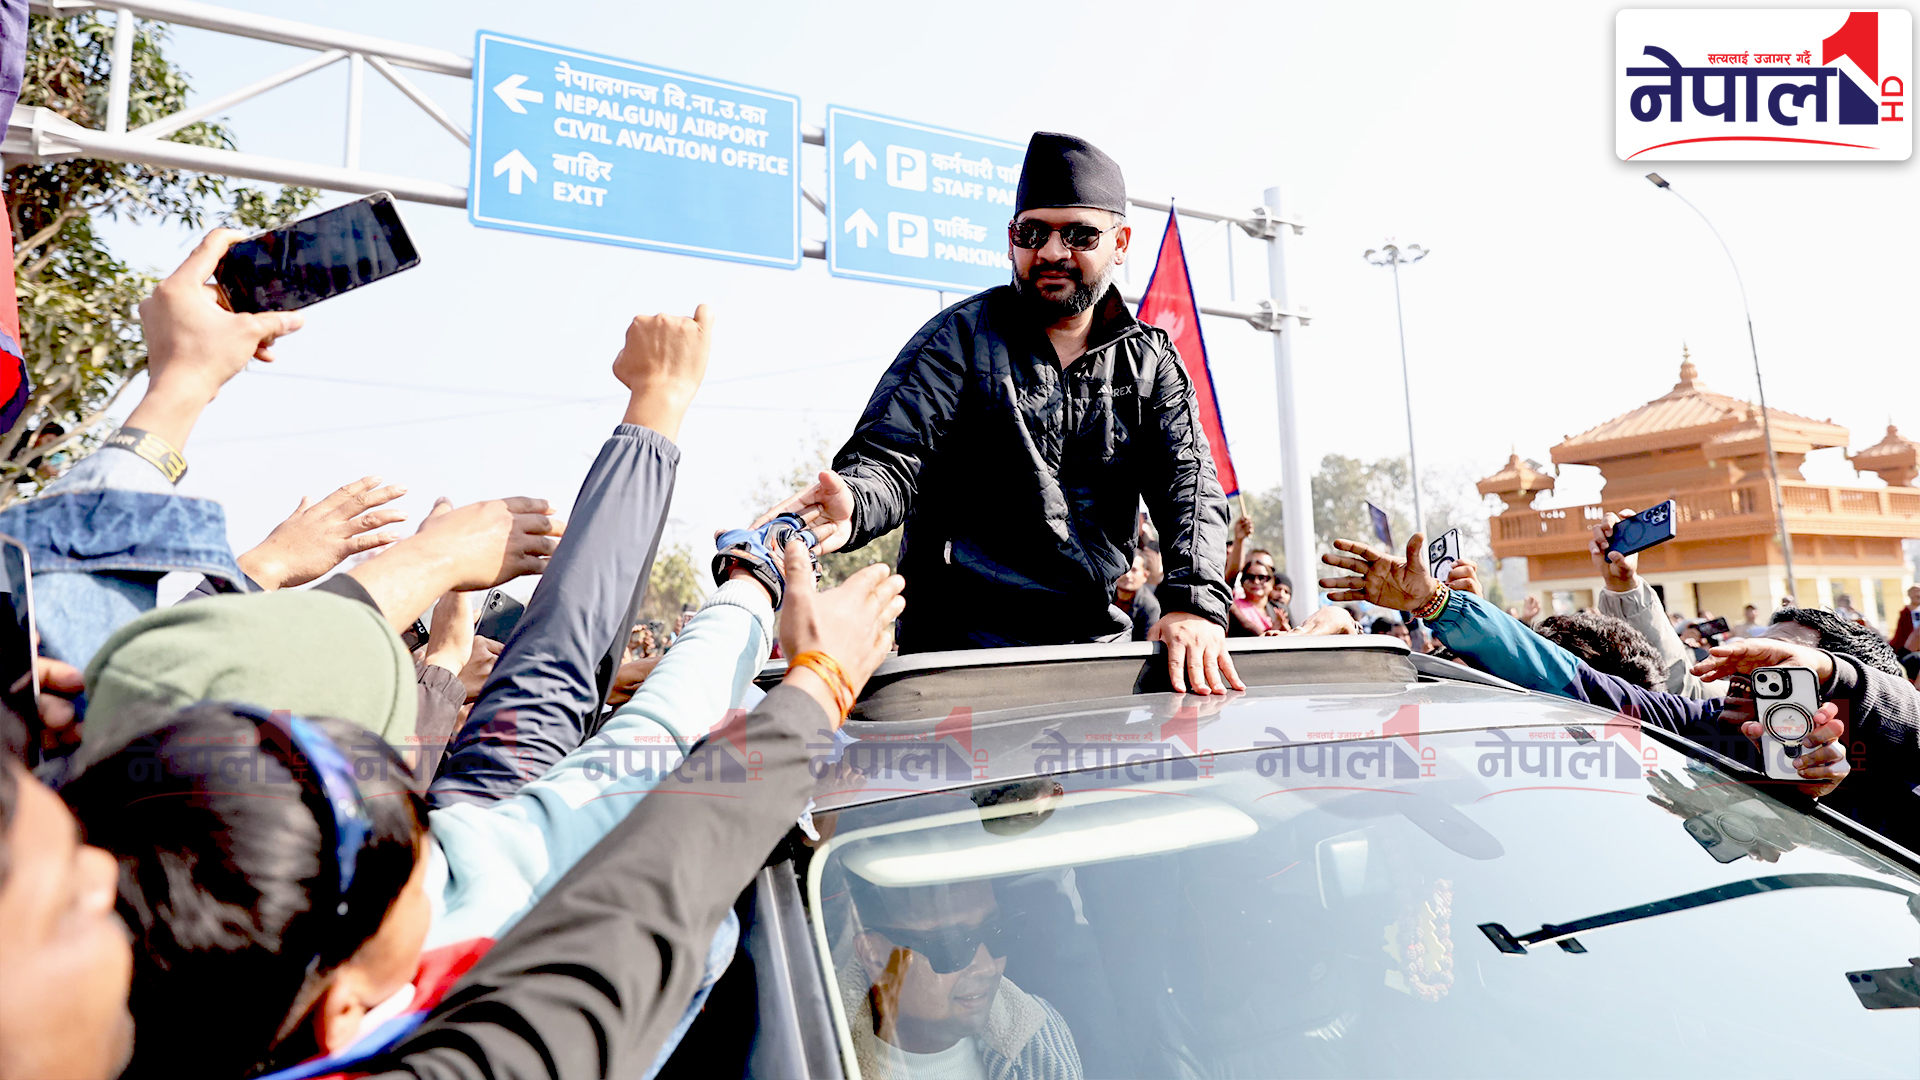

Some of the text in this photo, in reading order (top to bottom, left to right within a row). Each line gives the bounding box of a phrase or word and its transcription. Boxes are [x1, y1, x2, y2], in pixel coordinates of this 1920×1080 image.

[554, 61, 659, 104] नेपालगन्ज
[555, 91, 769, 148] NEPALGUNJ AIRPORT
[554, 117, 789, 176] CIVIL AVIATION OFFICE
[552, 151, 614, 183] बाहिर
[931, 152, 994, 180] कर्मचारी
[553, 181, 607, 207] EXIT
[932, 176, 983, 200] STAFF
[935, 242, 1013, 270] PARKING
